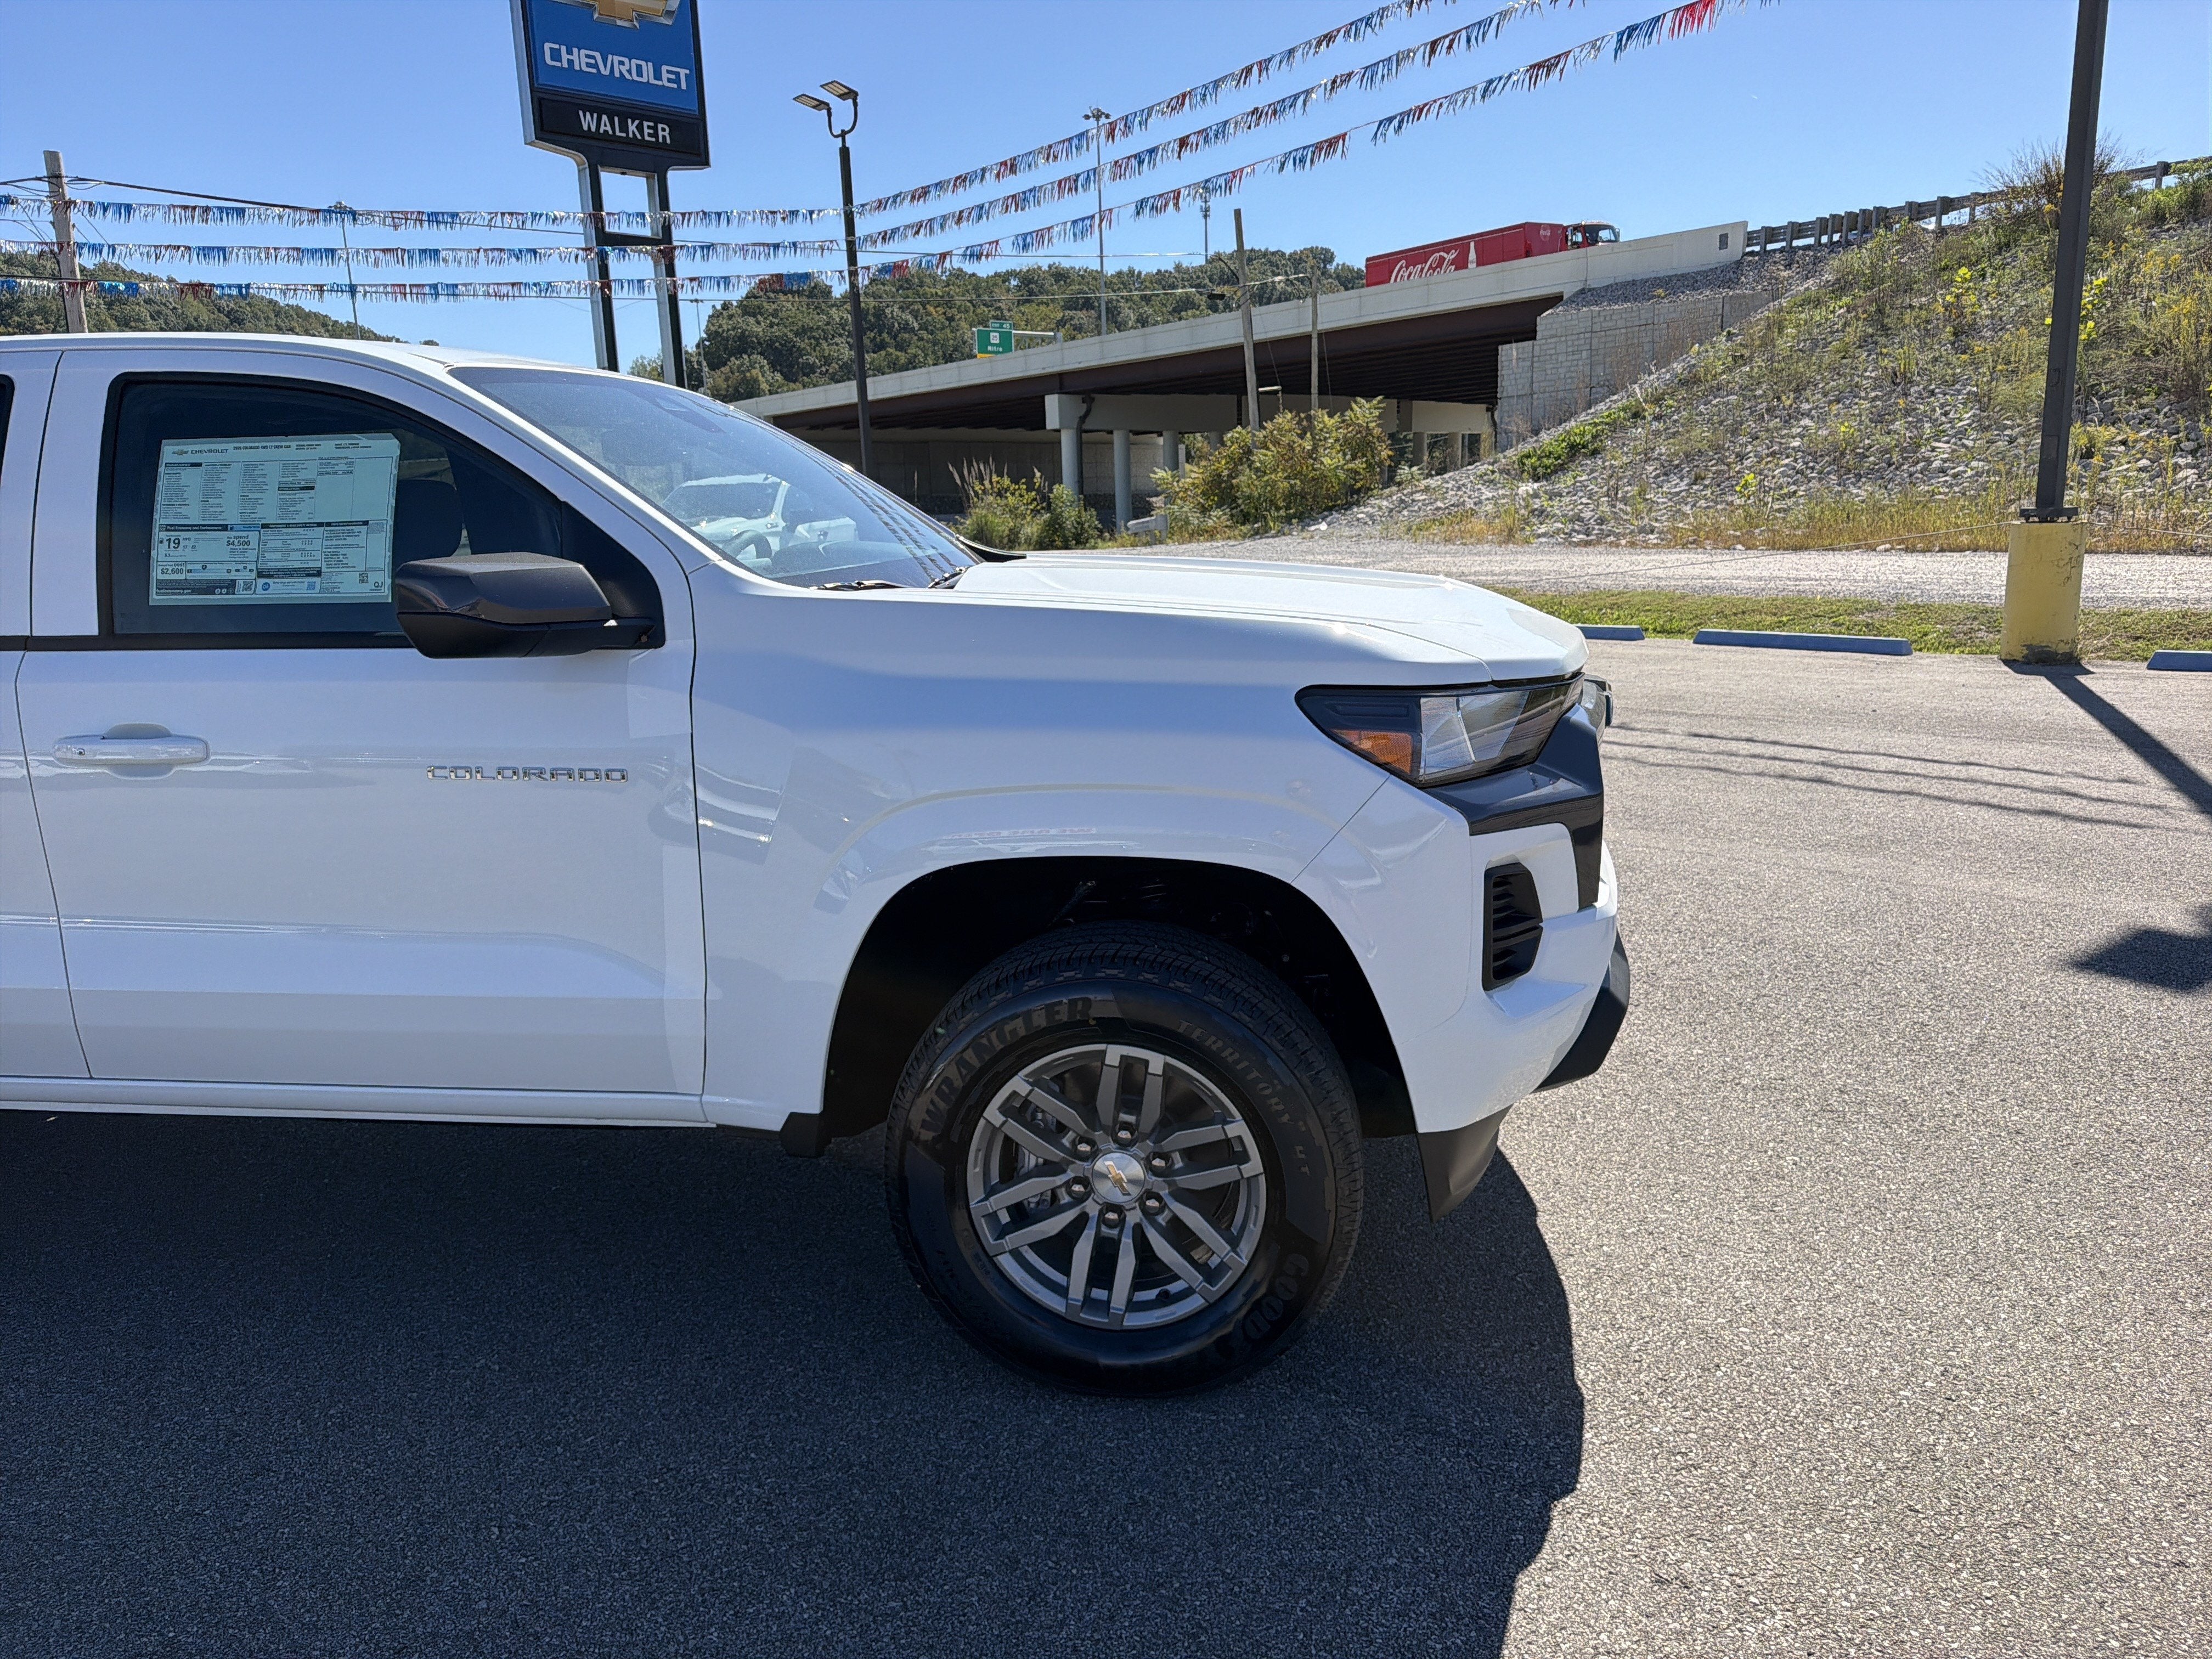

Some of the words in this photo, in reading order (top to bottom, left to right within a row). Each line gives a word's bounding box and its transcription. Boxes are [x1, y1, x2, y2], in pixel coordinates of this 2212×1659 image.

[544, 42, 690, 90] CHEVROLET
[578, 110, 670, 144] WALKER
[166, 537, 180, 549] 19
[426, 766, 628, 783] COLORADO
[919, 996, 1092, 1135] WRANGLER
[1177, 1019, 1295, 1125] TERRITORY
